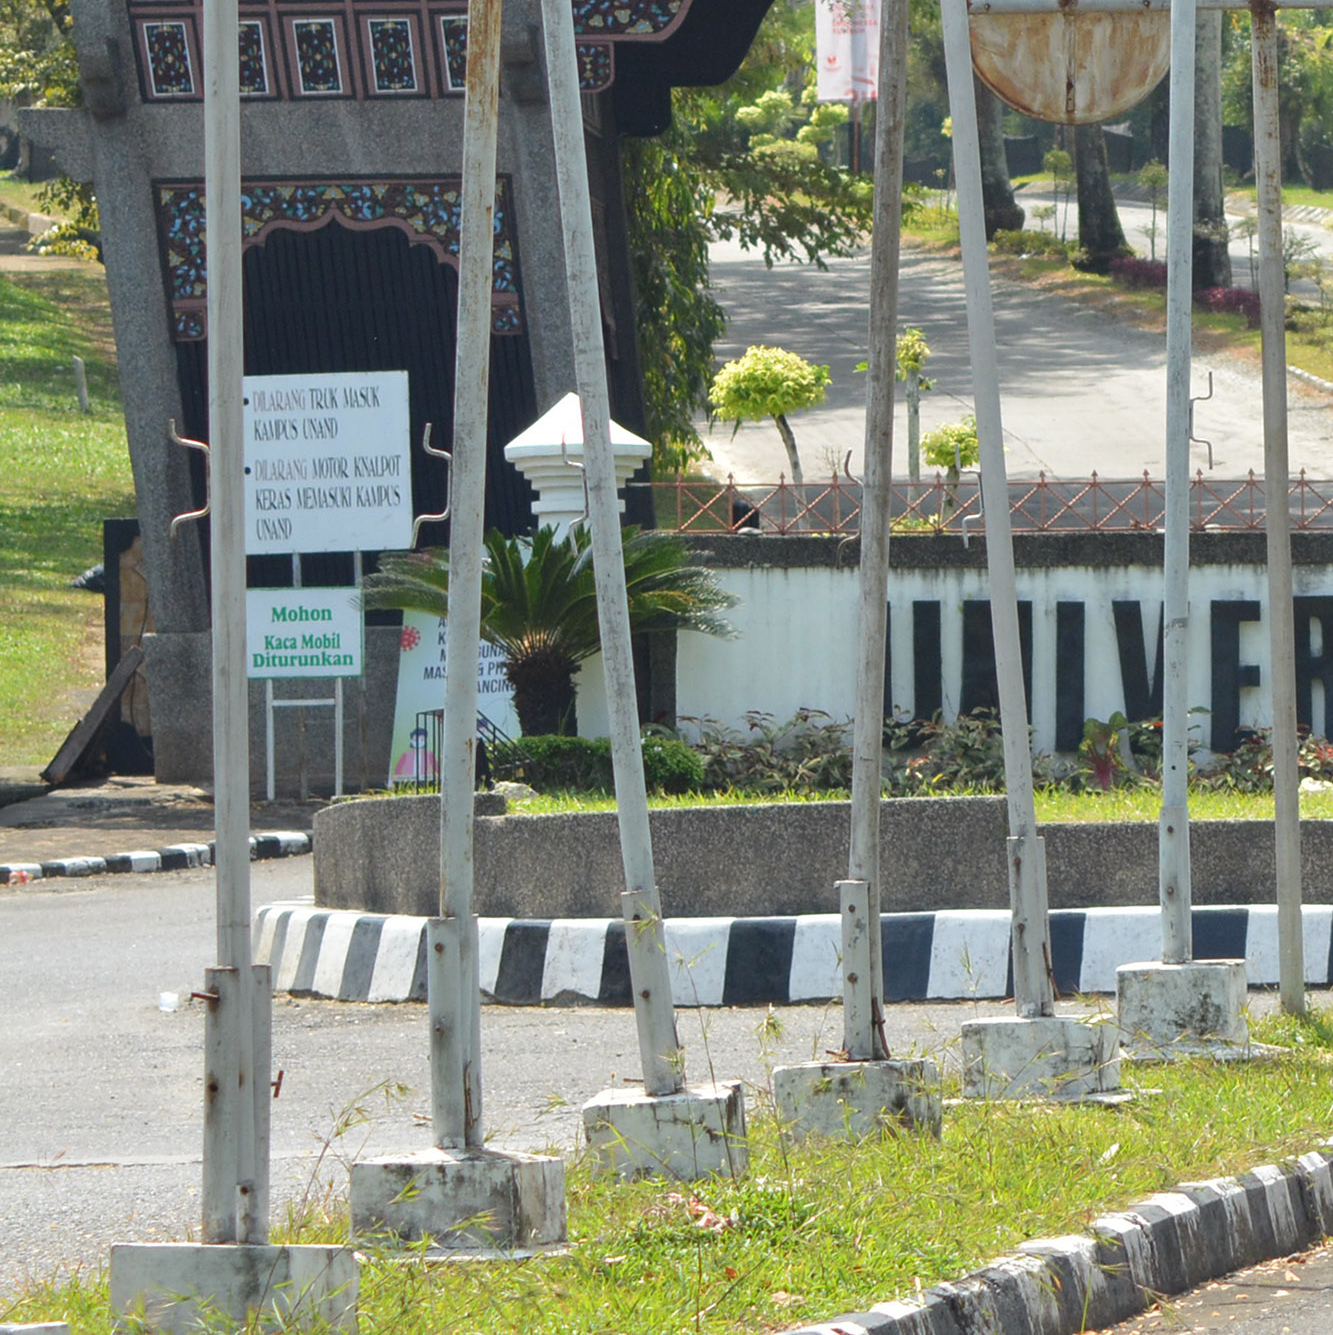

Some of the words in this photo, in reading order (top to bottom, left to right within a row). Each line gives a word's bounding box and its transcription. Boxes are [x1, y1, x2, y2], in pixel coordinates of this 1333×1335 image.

[253, 389, 306, 412] DILARANG
[309, 387, 339, 410] TRUK
[343, 386, 381, 408] MASUK
[254, 418, 299, 441] KAMPUS
[303, 417, 339, 440] UNAND
[255, 459, 308, 481] DILARANG
[312, 457, 349, 479] MOTOR
[354, 455, 401, 478] KNALPOT
[255, 488, 292, 511] KERAS
[296, 486, 352, 510] MEMASUKI
[356, 485, 401, 508] KAMPUS
[256, 518, 292, 541] UNAND
[271, 606, 332, 623] Mohon
[264, 634, 298, 651] Kaca
[301, 632, 341, 650] Mobil
[252, 651, 354, 669] Diturunkan
